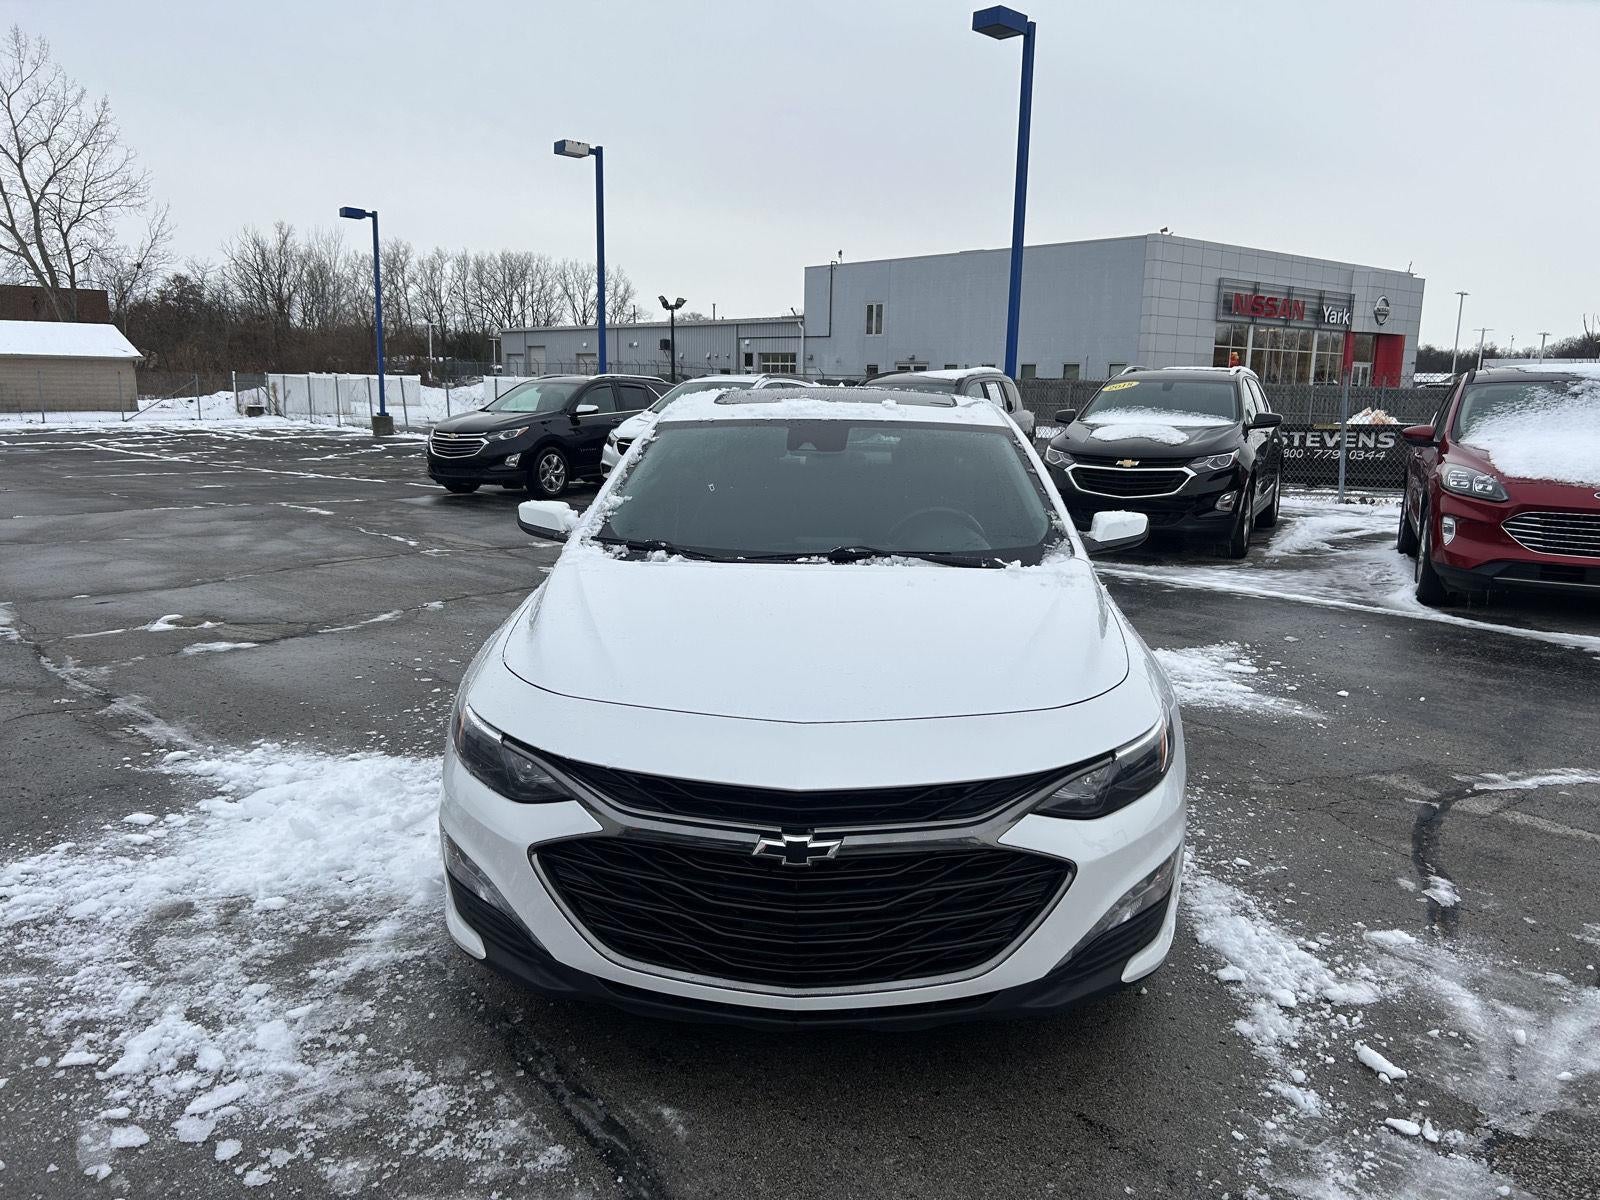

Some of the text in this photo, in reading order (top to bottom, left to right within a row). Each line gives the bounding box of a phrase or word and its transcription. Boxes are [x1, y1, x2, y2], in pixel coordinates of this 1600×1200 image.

[1232, 293, 1350, 325] NISSAN Yark
[1281, 431, 1396, 448] STEVENS
